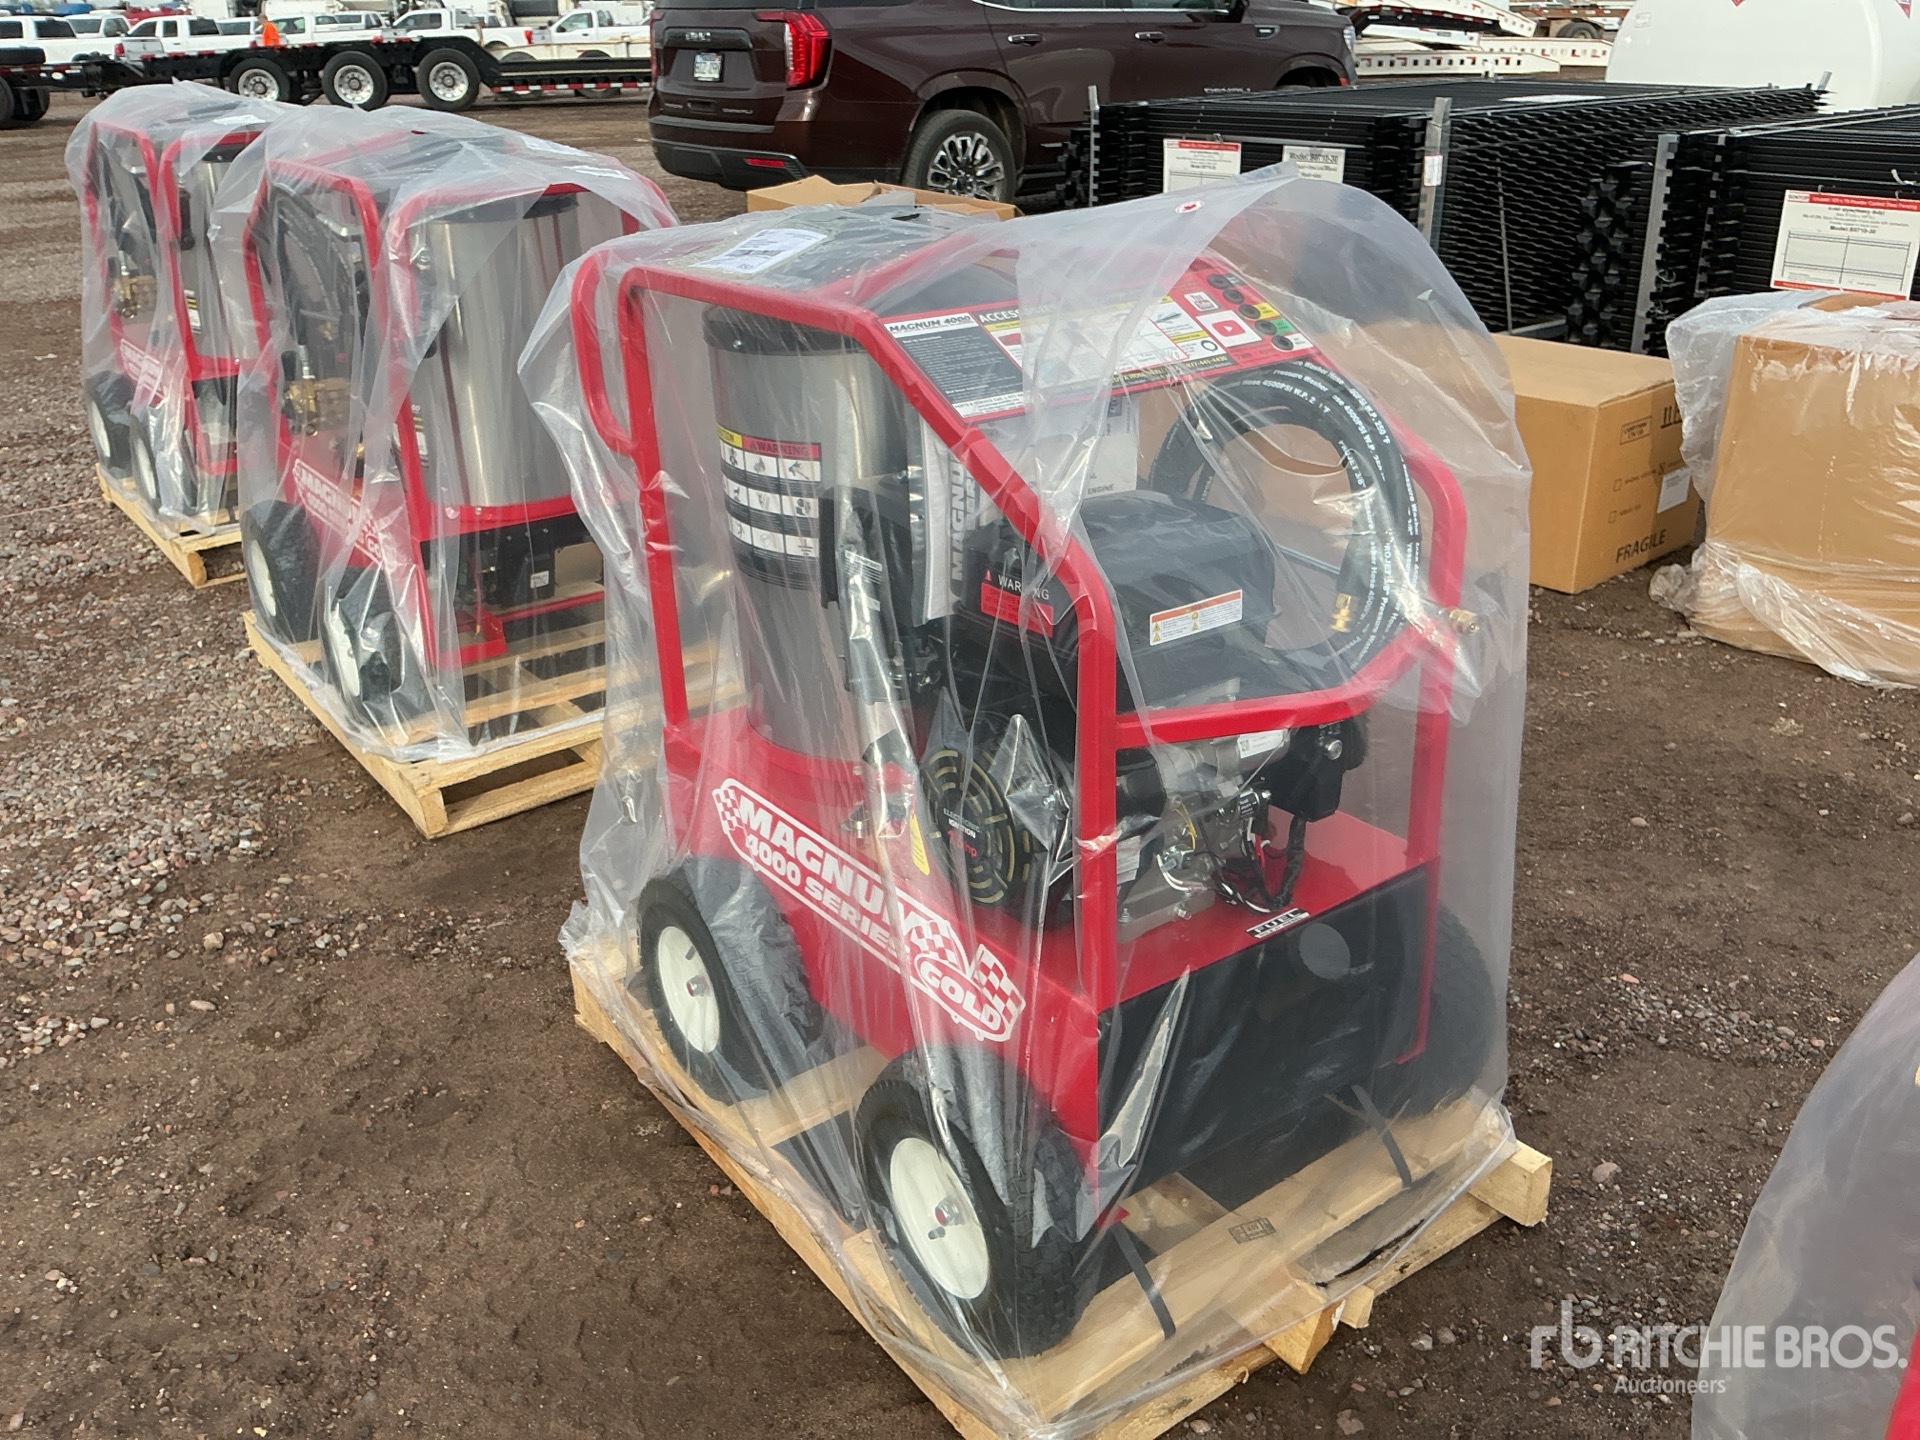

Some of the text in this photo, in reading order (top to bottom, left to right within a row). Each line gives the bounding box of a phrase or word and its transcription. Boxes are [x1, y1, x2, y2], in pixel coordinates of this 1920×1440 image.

[889, 315, 971, 333] MAGNUM 4000
[1262, 379, 1294, 392] 4500PSI
[1303, 375, 1329, 392] Washer
[1344, 405, 1368, 436] 4500PSI
[1374, 420, 1387, 436] 250
[757, 441, 809, 456] WARNING
[1087, 484, 1114, 495] ENGINE
[1615, 529, 1667, 563] FRAGILE
[998, 574, 1050, 600] WARNG
[738, 795, 924, 938] MAGNUM
[745, 833, 910, 957] 4000 SERIES
[1254, 912, 1301, 933] FUEL
[921, 962, 1003, 1030] GOLD
